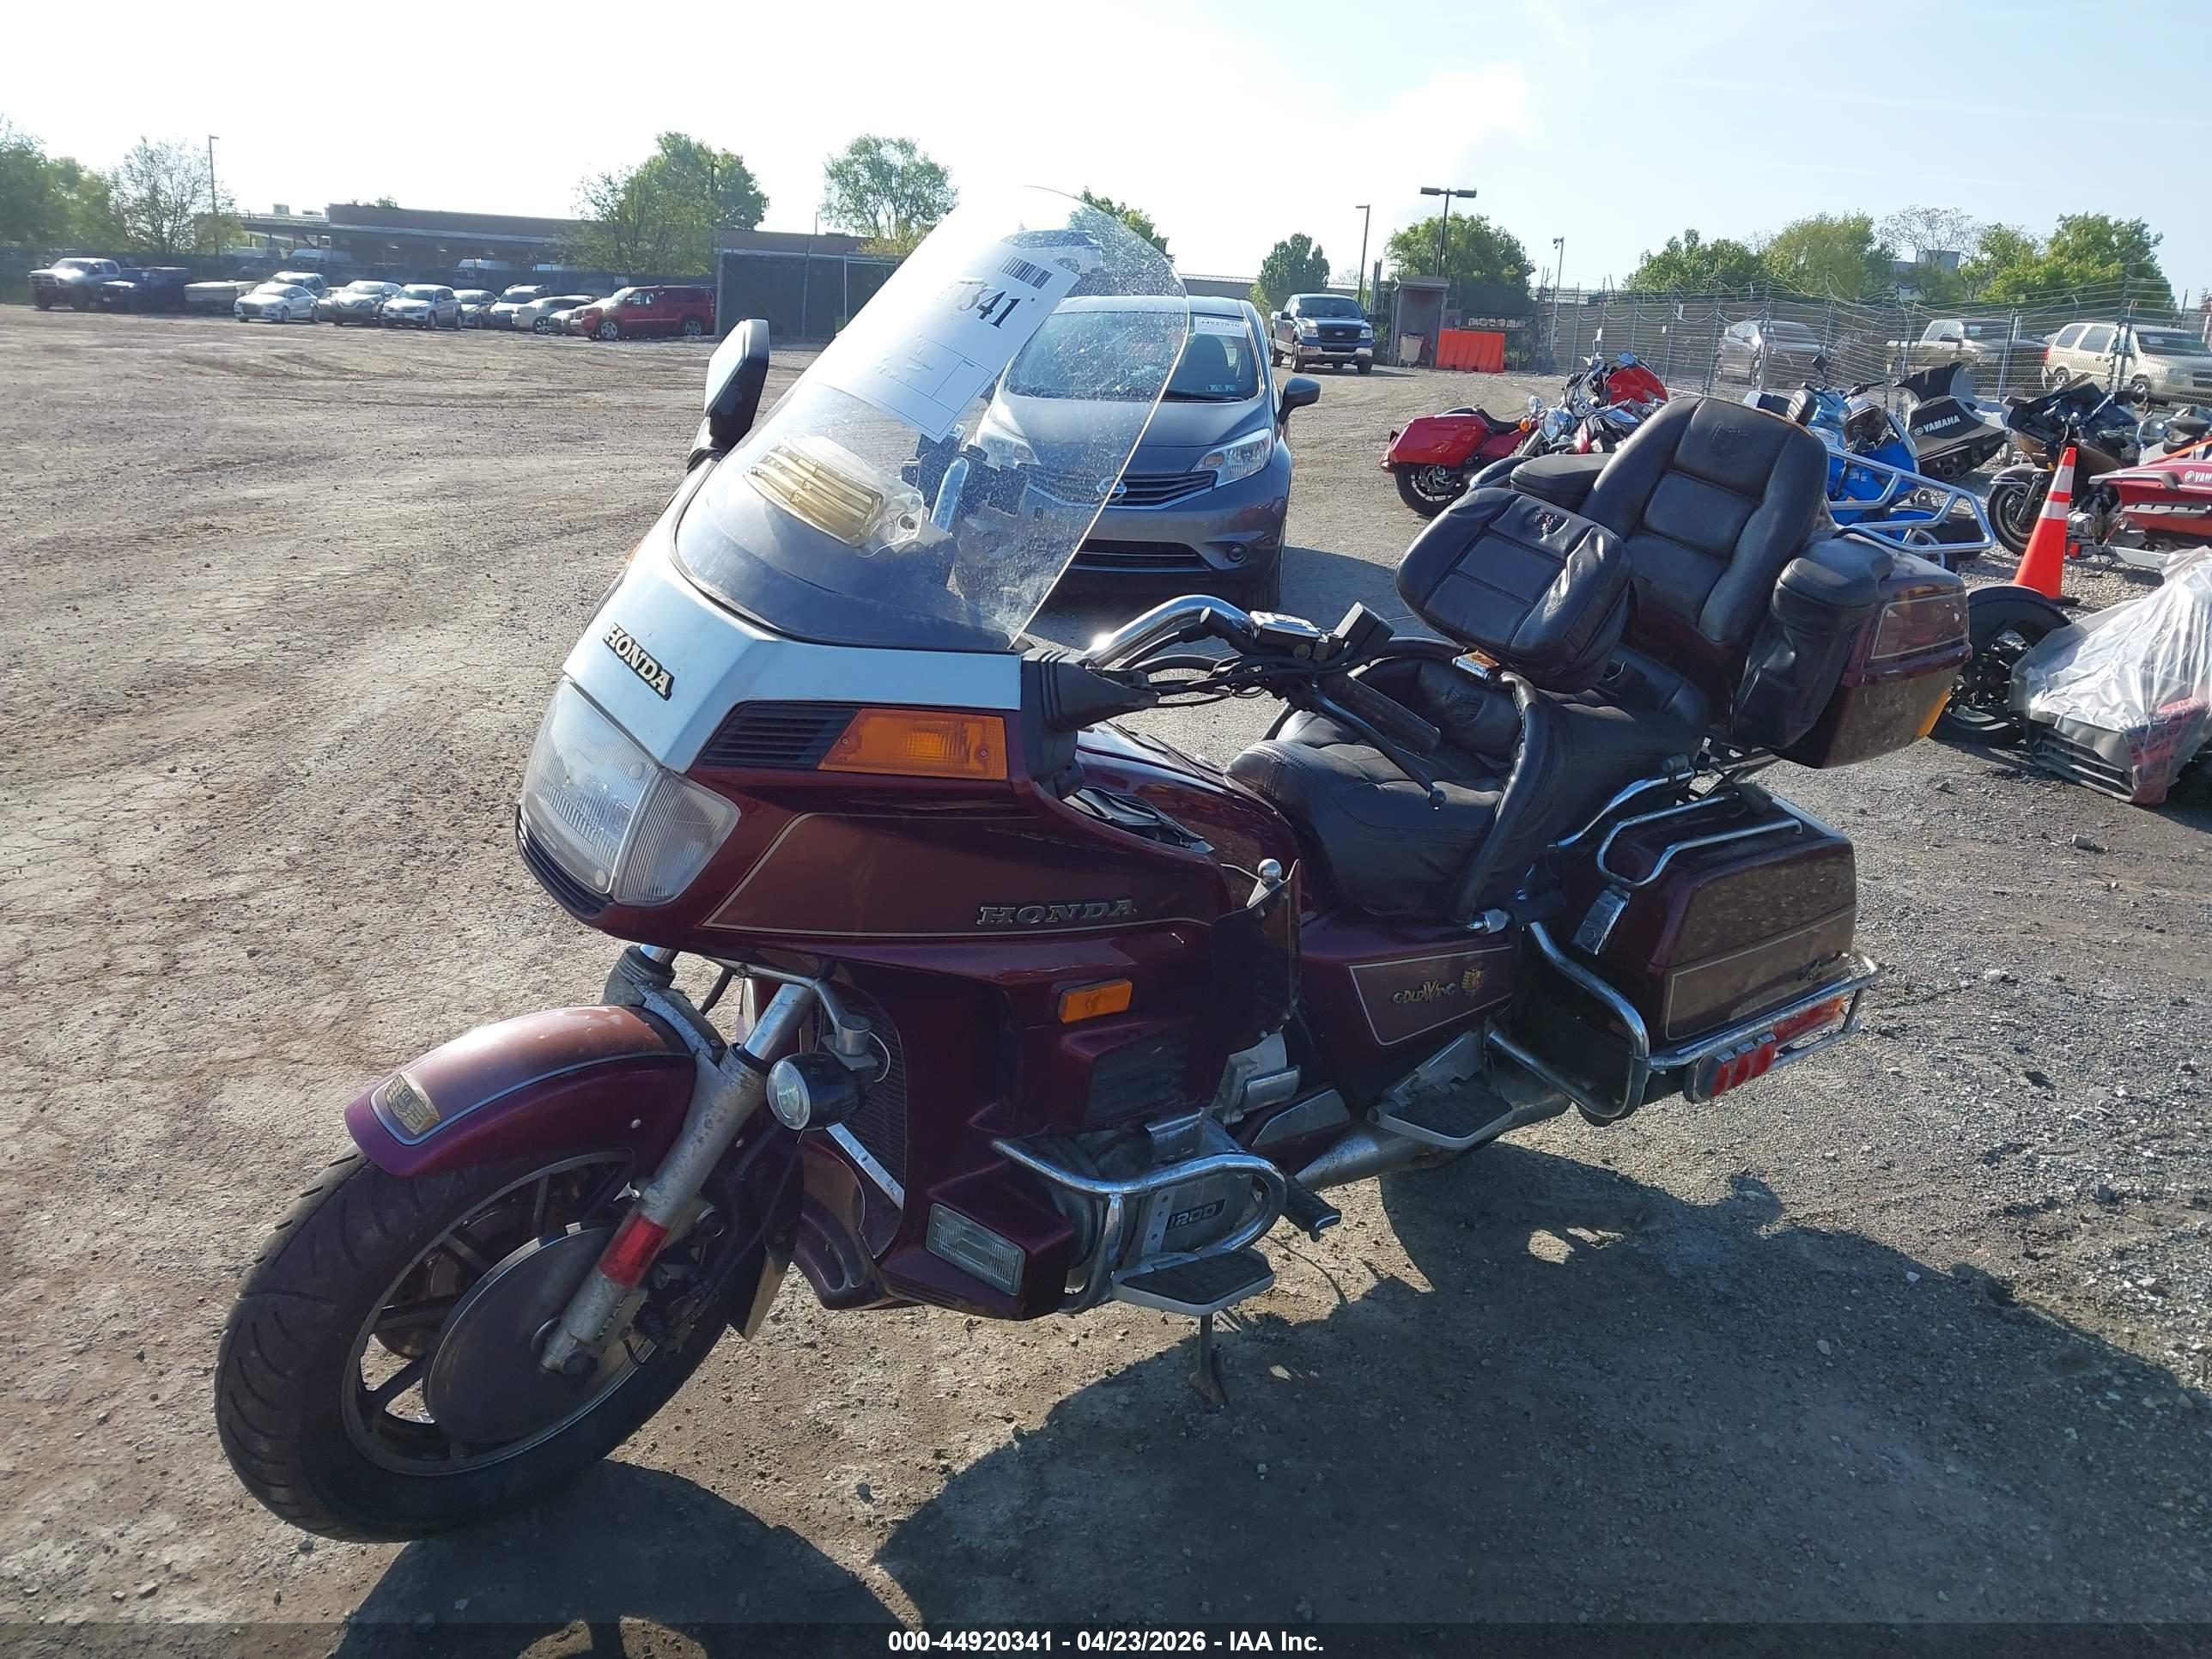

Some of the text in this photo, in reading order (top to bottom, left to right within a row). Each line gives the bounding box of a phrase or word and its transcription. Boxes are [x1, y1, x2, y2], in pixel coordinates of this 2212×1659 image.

[1923, 414, 1960, 433] YAMAHA
[603, 623, 672, 697] HONDA
[976, 897, 1138, 926] HONDA
